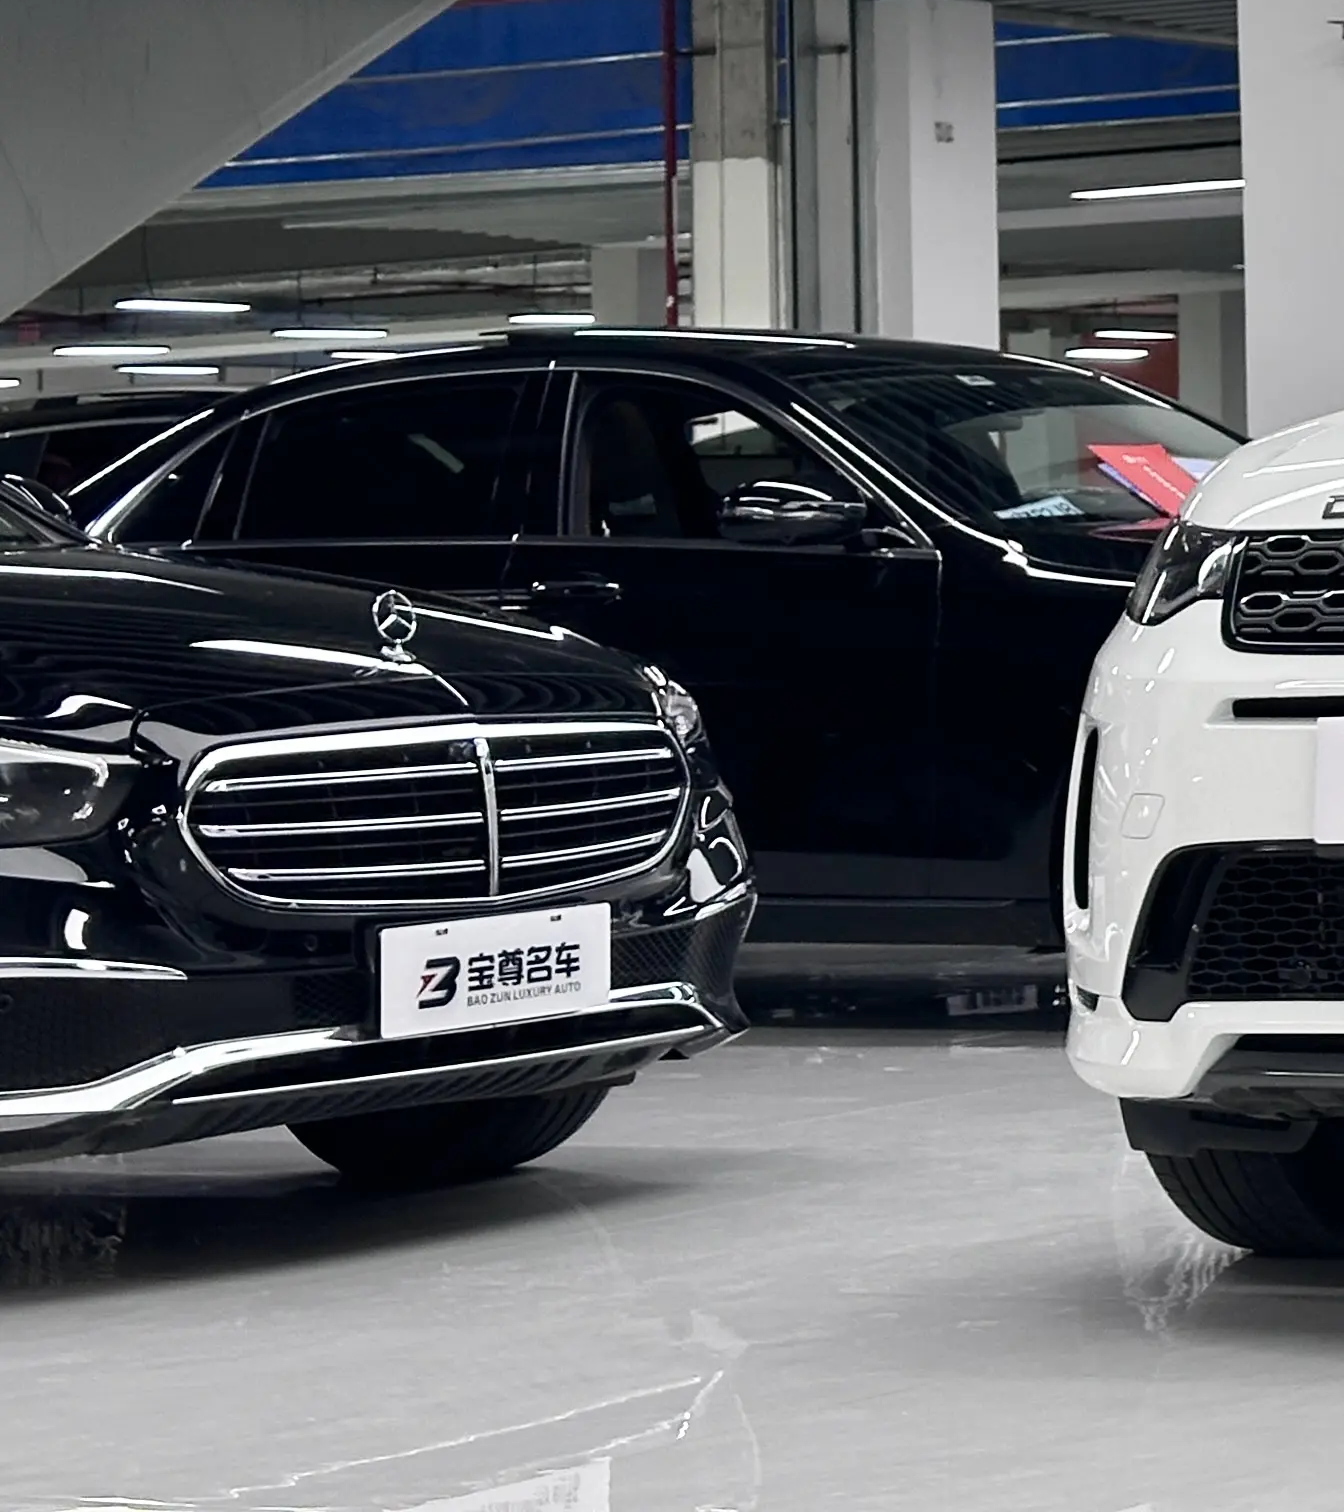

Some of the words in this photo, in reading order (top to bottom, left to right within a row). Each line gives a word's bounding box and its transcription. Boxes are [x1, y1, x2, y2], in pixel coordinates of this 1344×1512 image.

[467, 942, 580, 992] 宝尊名车
[467, 994, 488, 1006] BAO
[490, 990, 511, 1004] ZUN
[513, 986, 551, 1001] LUXURY
[554, 981, 582, 994] AUTO
